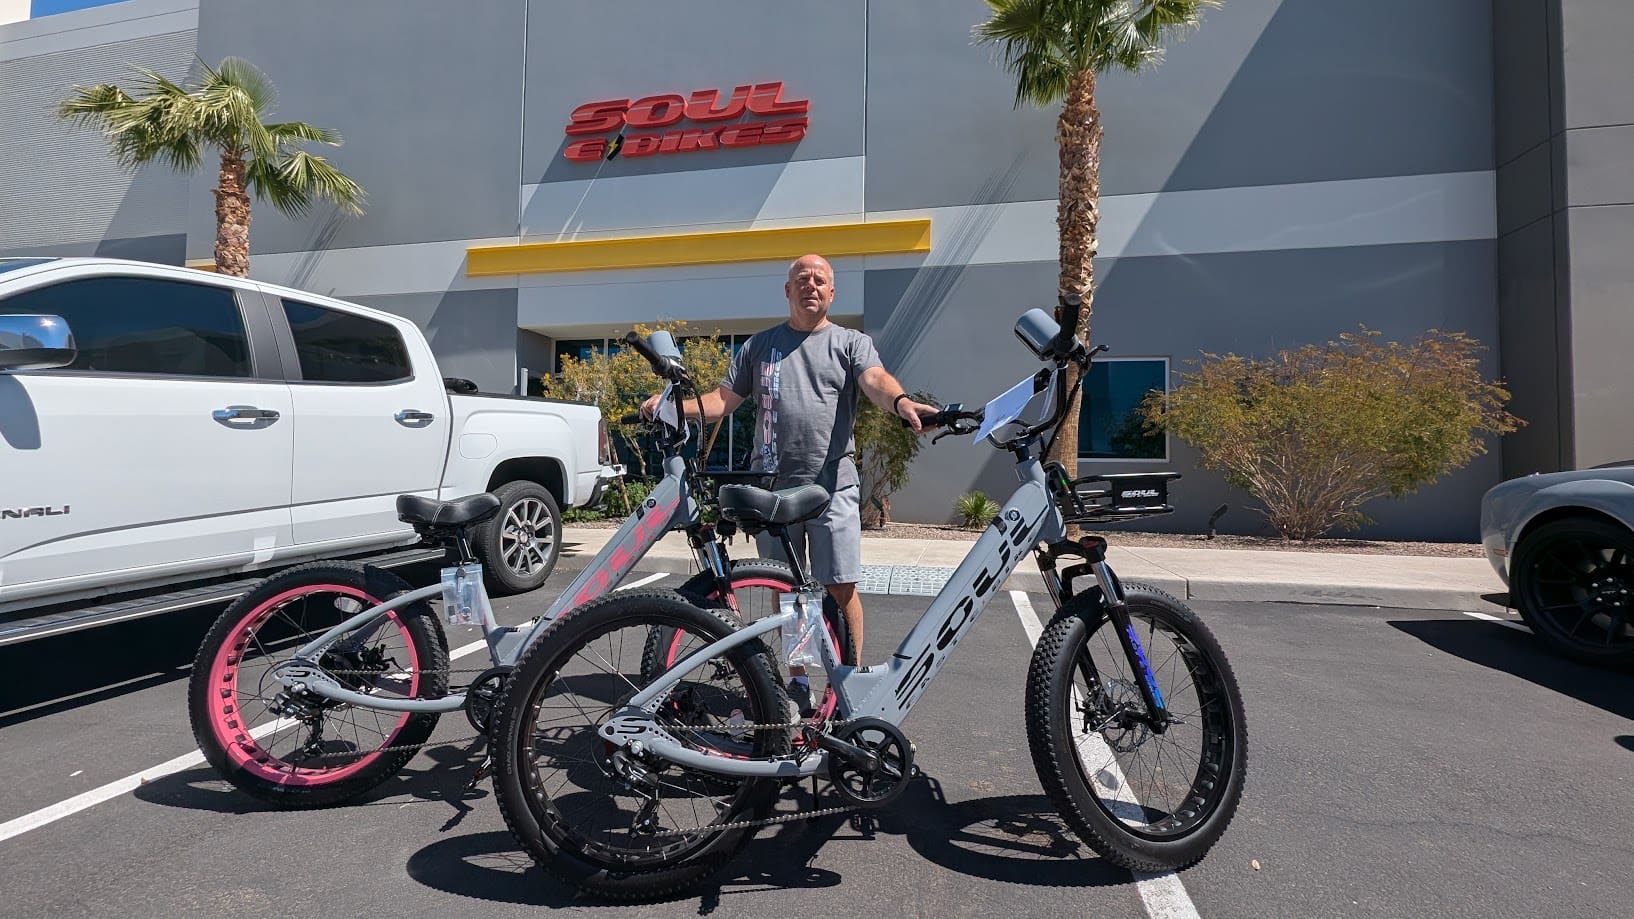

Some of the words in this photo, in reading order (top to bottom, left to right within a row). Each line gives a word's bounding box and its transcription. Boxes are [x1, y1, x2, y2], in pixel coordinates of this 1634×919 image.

[565, 81, 809, 136] SOUL
[0, 505, 70, 520] NALI
[894, 505, 1049, 711] SOUL
